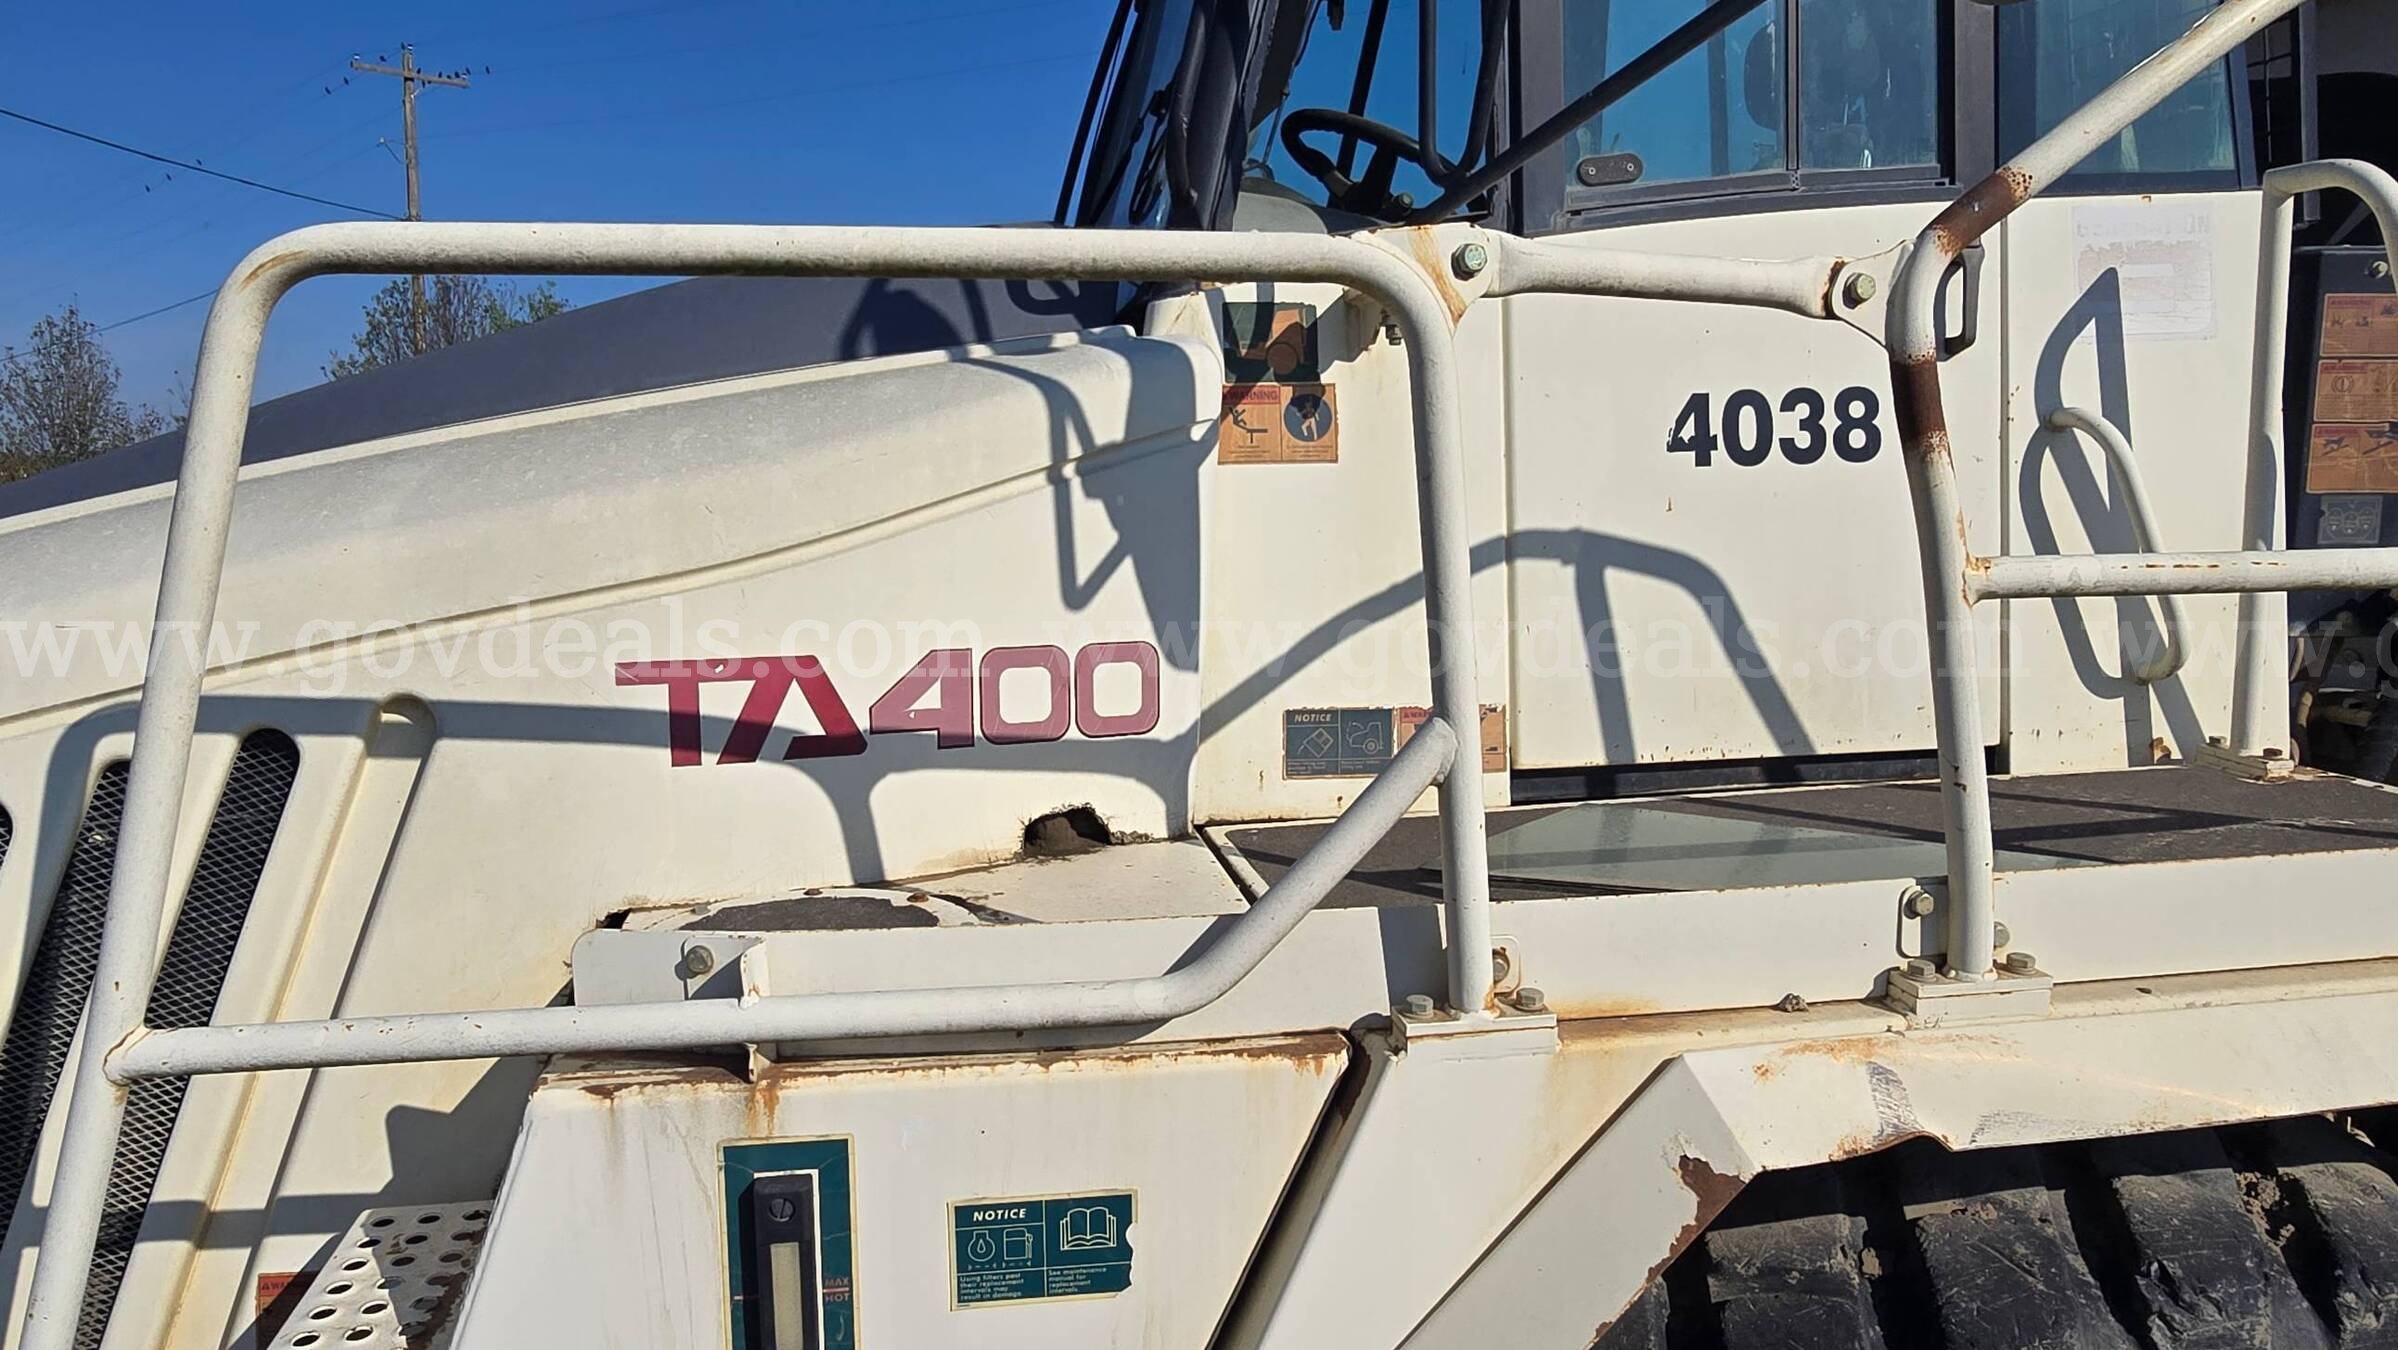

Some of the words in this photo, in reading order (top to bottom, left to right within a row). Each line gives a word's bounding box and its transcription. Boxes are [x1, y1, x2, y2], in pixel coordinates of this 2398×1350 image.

[1666, 386, 1882, 467] 4038
[615, 641, 1160, 767] TA400
[1293, 712, 1333, 723] NOTICE
[972, 1208, 1027, 1222] NOTICE
[824, 1277, 849, 1287] MAX
[825, 1293, 850, 1302] HOT
